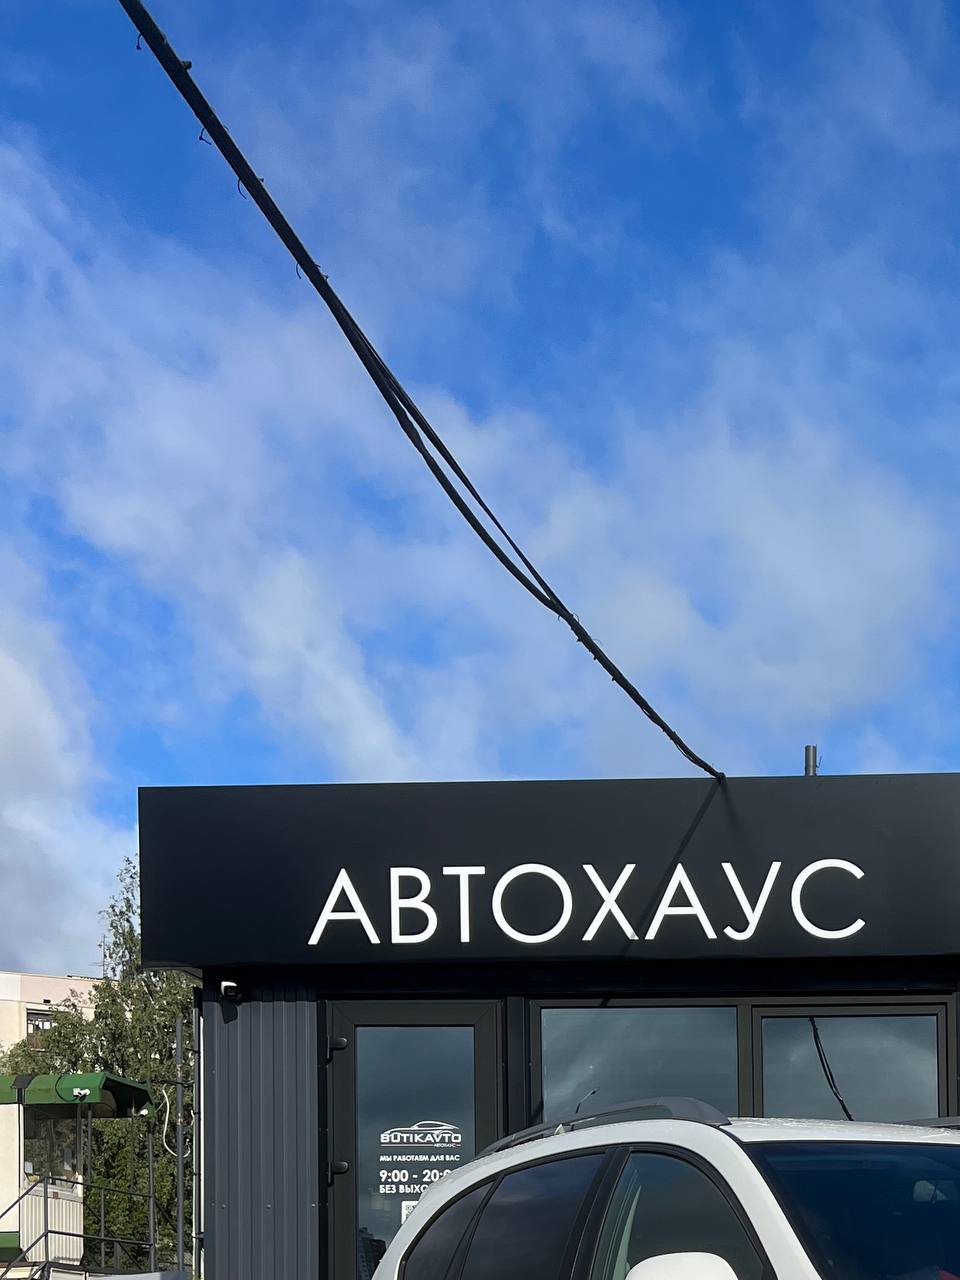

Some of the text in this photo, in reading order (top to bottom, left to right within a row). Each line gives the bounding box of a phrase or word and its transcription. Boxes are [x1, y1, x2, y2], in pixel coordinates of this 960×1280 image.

[307, 858, 866, 946] АВТОХАУС
[380, 1133, 462, 1143] BUTIKAVTO
[379, 1169, 409, 1182] 9:00
[422, 1169, 452, 1182] 20:
[379, 1184, 396, 1194] БЕЗ
